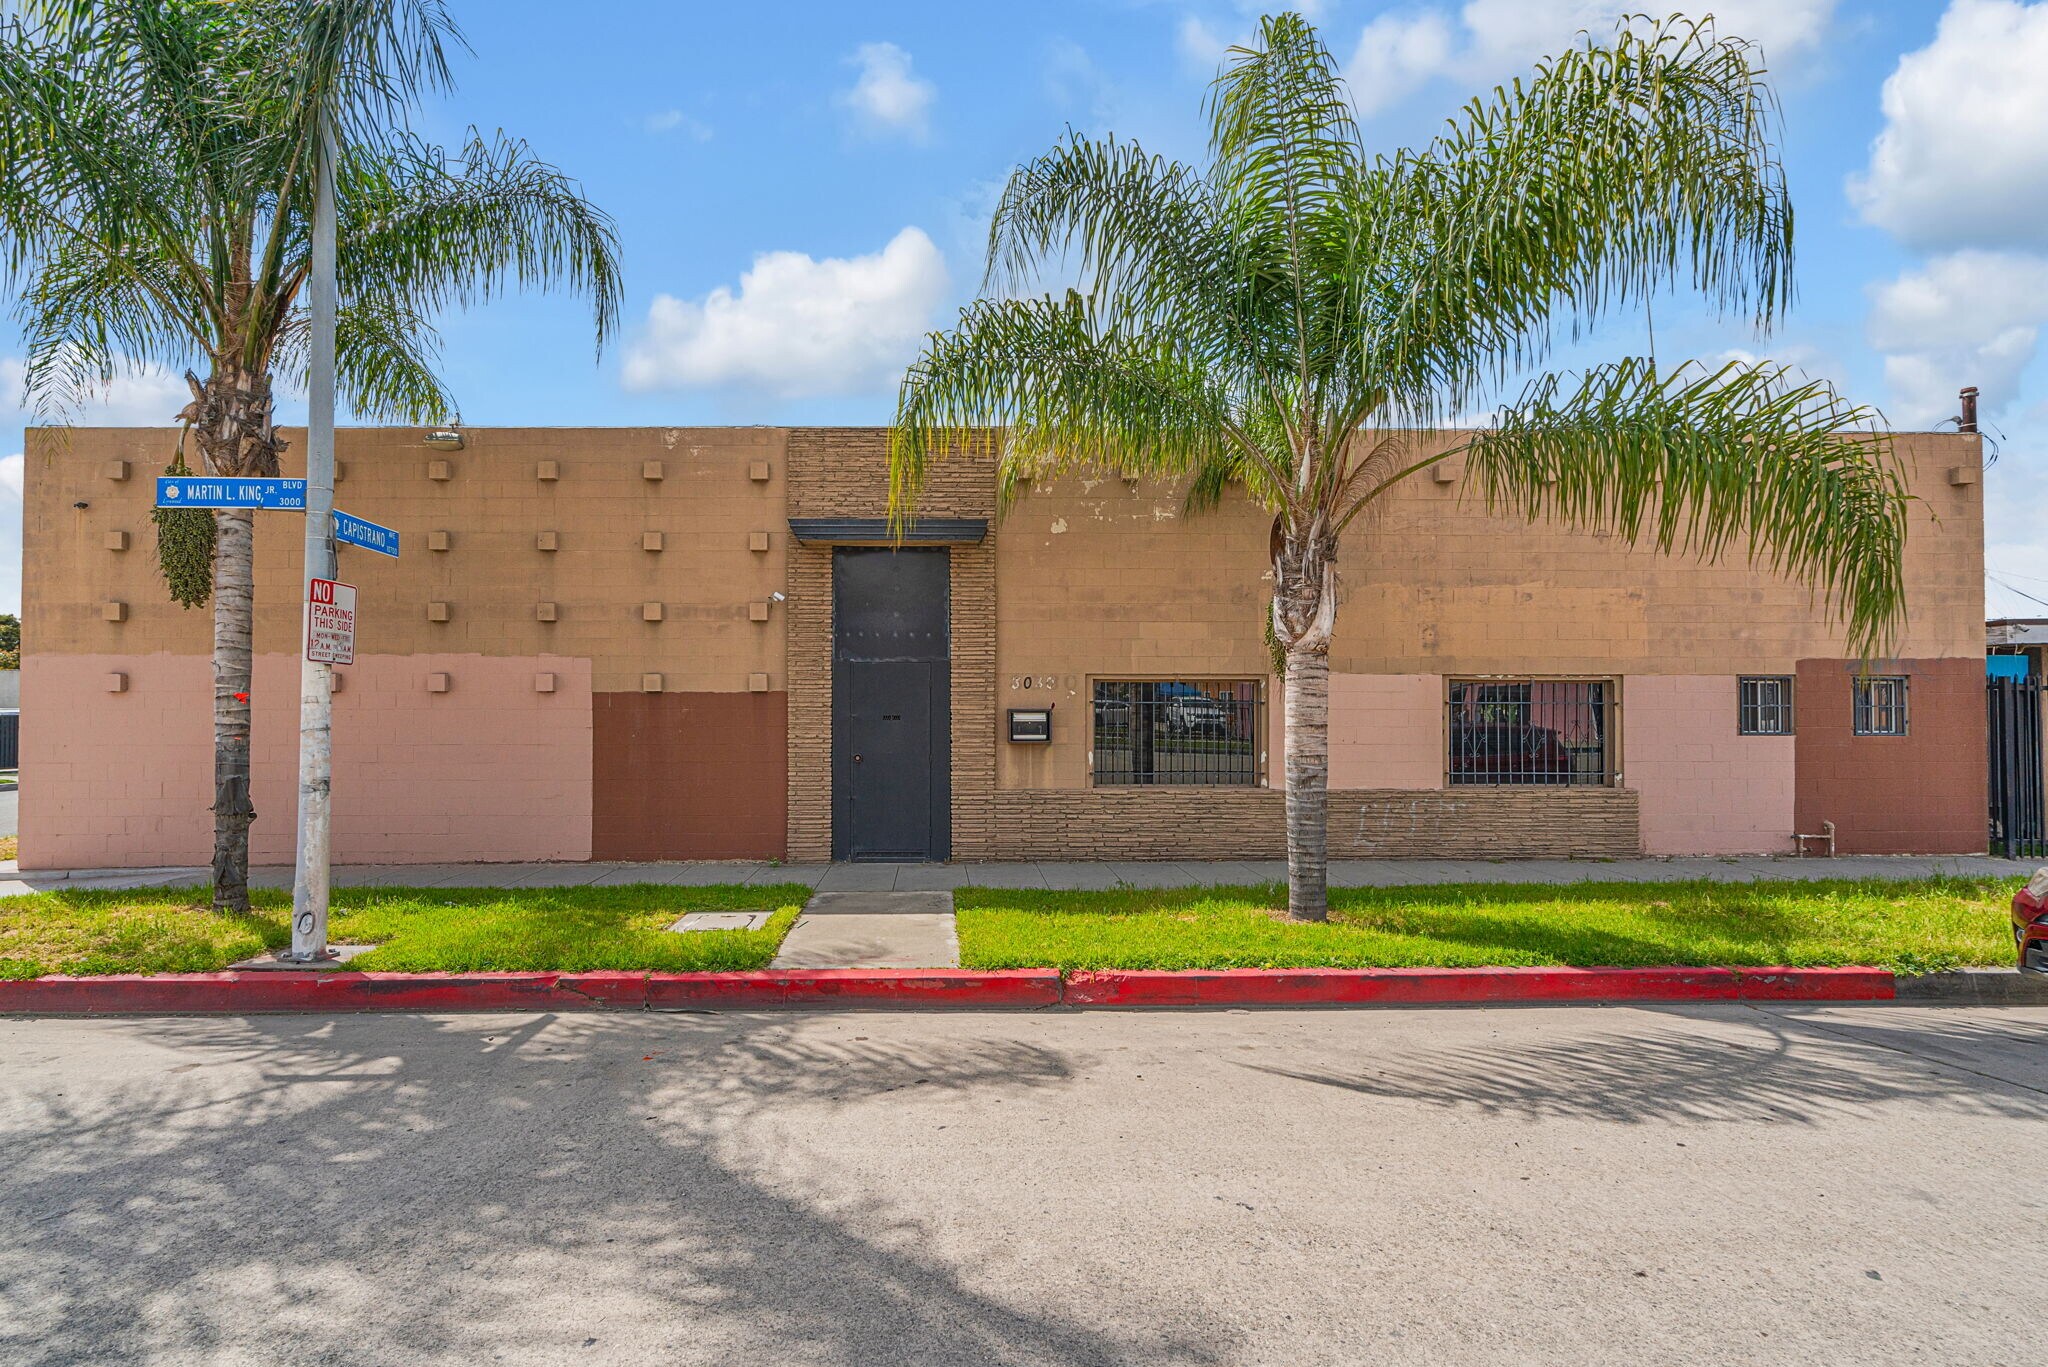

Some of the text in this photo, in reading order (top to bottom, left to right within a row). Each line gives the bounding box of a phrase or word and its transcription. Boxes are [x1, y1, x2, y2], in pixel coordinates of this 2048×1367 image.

[187, 480, 303, 504] MARTIN L. KING, JR. BLVD
[279, 497, 301, 506] 3000
[343, 519, 386, 548] CAPISTRANO
[313, 581, 331, 602] NO
[314, 604, 353, 621] PARKING
[314, 616, 352, 633] THIS SIDE
[311, 650, 331, 658] STREET
